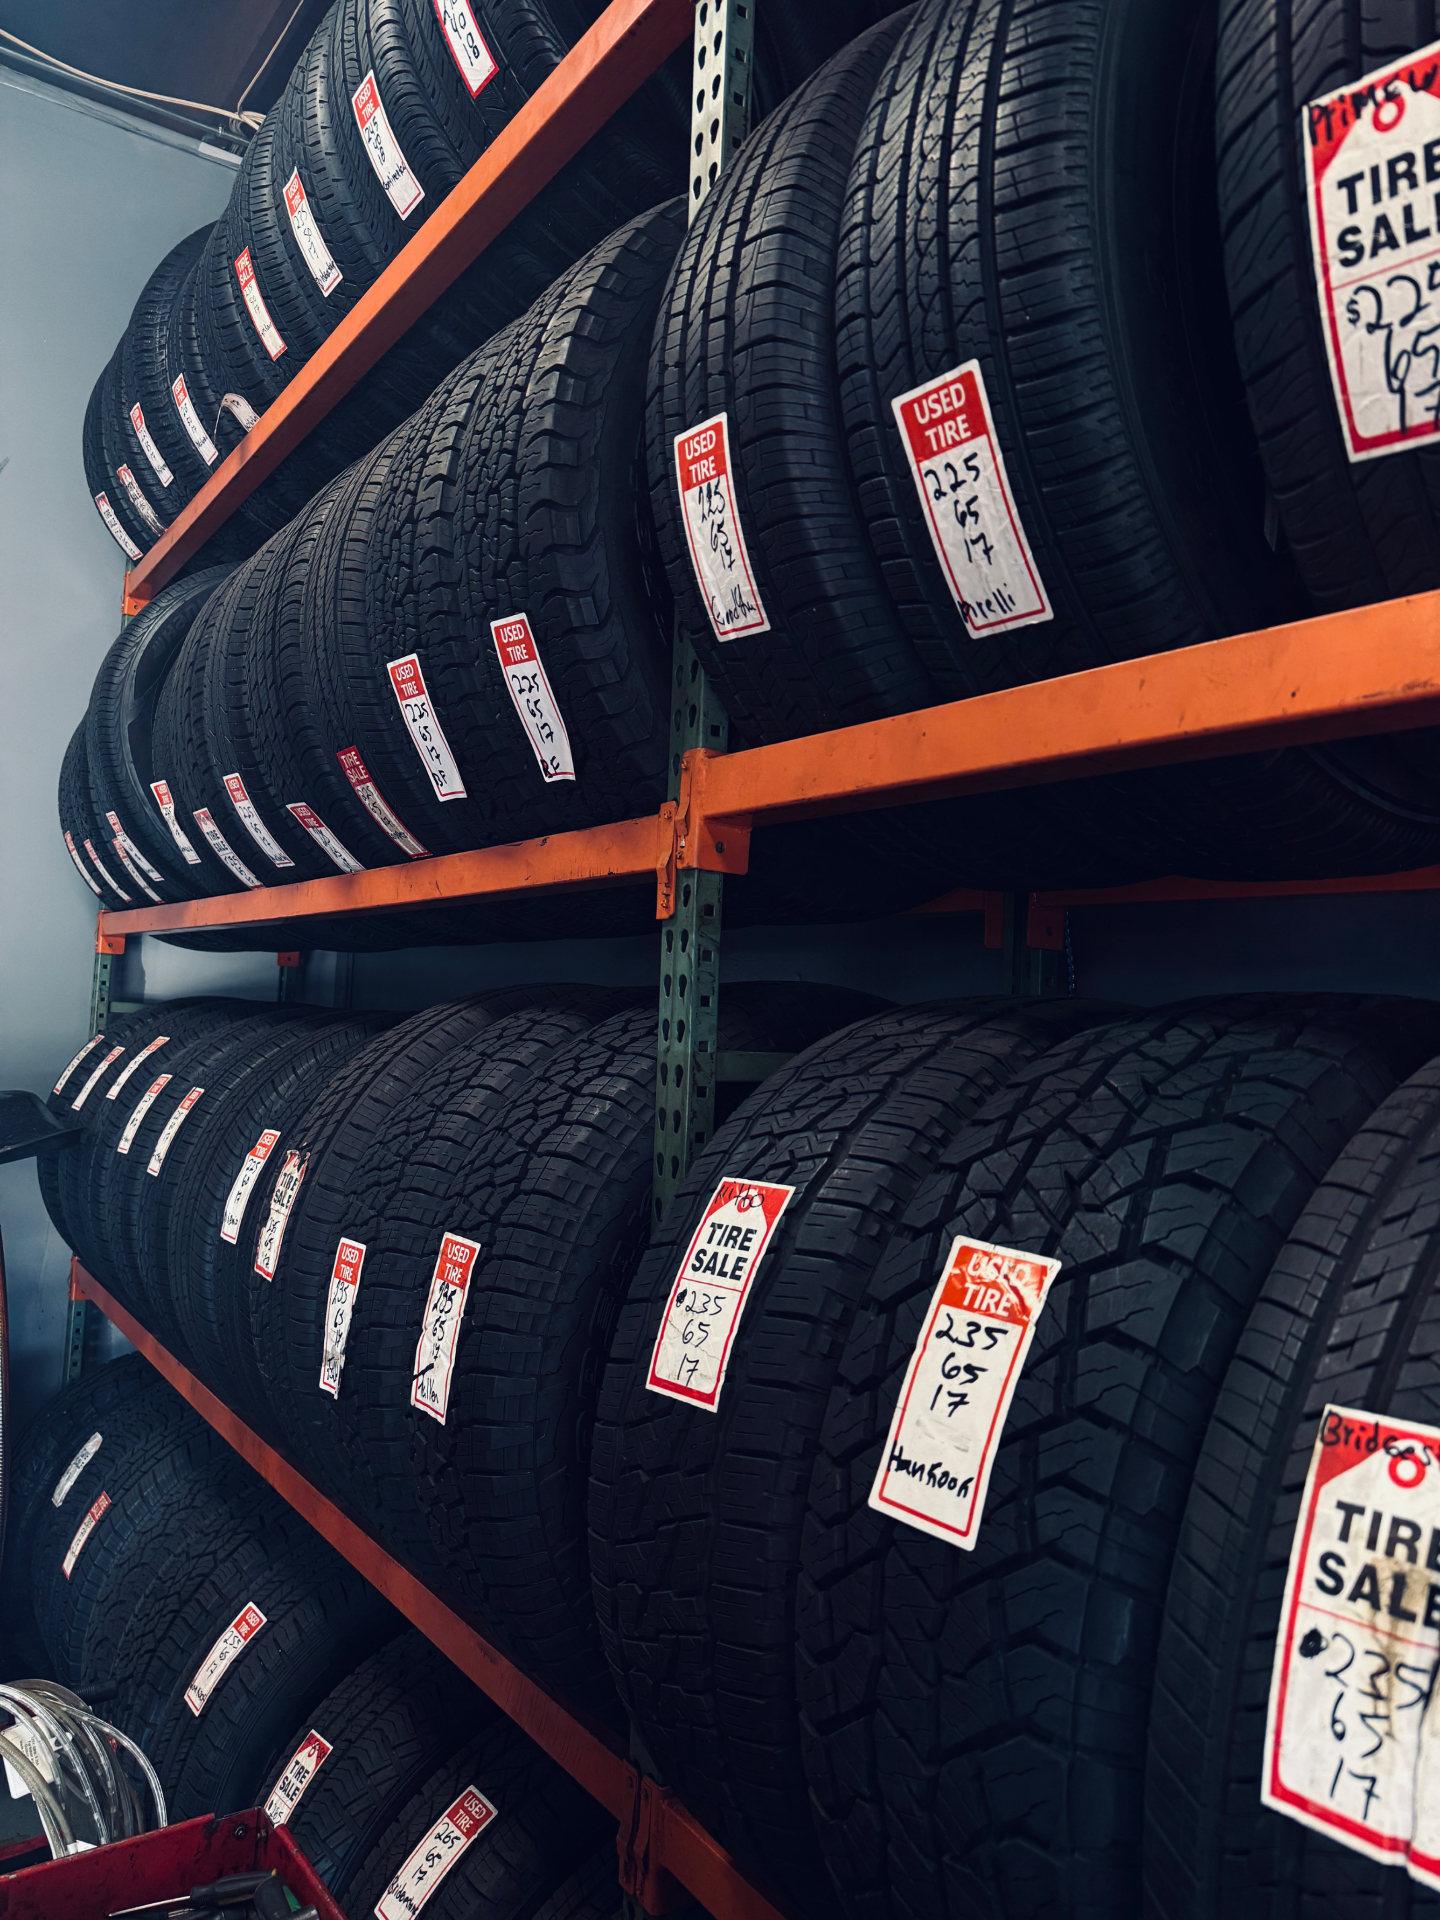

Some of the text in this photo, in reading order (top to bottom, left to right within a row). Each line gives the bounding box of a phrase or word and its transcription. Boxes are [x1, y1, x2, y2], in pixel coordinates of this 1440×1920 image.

[357, 83, 372, 109] USED
[361, 99, 375, 122] TIRE
[364, 115, 379, 144] 245
[287, 178, 299, 199] USED
[1337, 192, 1440, 267] SAL
[237, 252, 250, 272] TIRE
[239, 265, 254, 286] SALE
[913, 382, 966, 425] USED
[684, 429, 716, 461] USED
[924, 413, 972, 452] TIRE
[688, 455, 717, 484] TIRE
[923, 451, 981, 501] 225
[954, 495, 980, 528] 65
[710, 516, 729, 552] 65
[719, 545, 736, 572] 17
[964, 532, 994, 566] 17
[499, 623, 525, 643] USED
[506, 645, 529, 663] TIRE
[394, 663, 415, 682] USED
[511, 672, 540, 695] 225
[400, 680, 419, 698] TIRE
[404, 701, 429, 724] 225
[526, 698, 543, 719] 65
[418, 725, 432, 742] 65
[535, 721, 554, 744] 17
[340, 751, 361, 769] TIRE
[425, 745, 442, 766] 17
[346, 764, 369, 784] SALE
[279, 1172, 299, 1192] TIRE
[273, 1188, 292, 1210] SALE
[706, 1222, 758, 1252] TIRE
[341, 1245, 359, 1264] USED
[447, 1242, 470, 1264] USED
[691, 1248, 749, 1281] SALE
[339, 1263, 354, 1282] TIRE
[445, 1263, 463, 1284] TIRE
[967, 1253, 1032, 1289] USED
[685, 1290, 727, 1316] 235
[962, 1282, 1014, 1318] TIRE
[432, 1315, 445, 1342] 65
[682, 1319, 711, 1348] 65
[935, 1312, 1009, 1350] 235
[677, 1353, 700, 1388] 17
[941, 1352, 989, 1385] 65
[930, 1384, 970, 1418] 17
[1320, 1409, 1440, 1466] Bridges
[237, 1620, 251, 1637] TIRE
[245, 1609, 260, 1627] USED
[1325, 1632, 1431, 1710] 235
[289, 1759, 310, 1786] TIRE
[279, 1775, 300, 1802] SALE
[1329, 1756, 1381, 1821] 17
[463, 1794, 487, 1820] USED
[453, 1808, 474, 1833] TIRE
[434, 1822, 461, 1850] 265
[411, 1863, 428, 1886] 17
